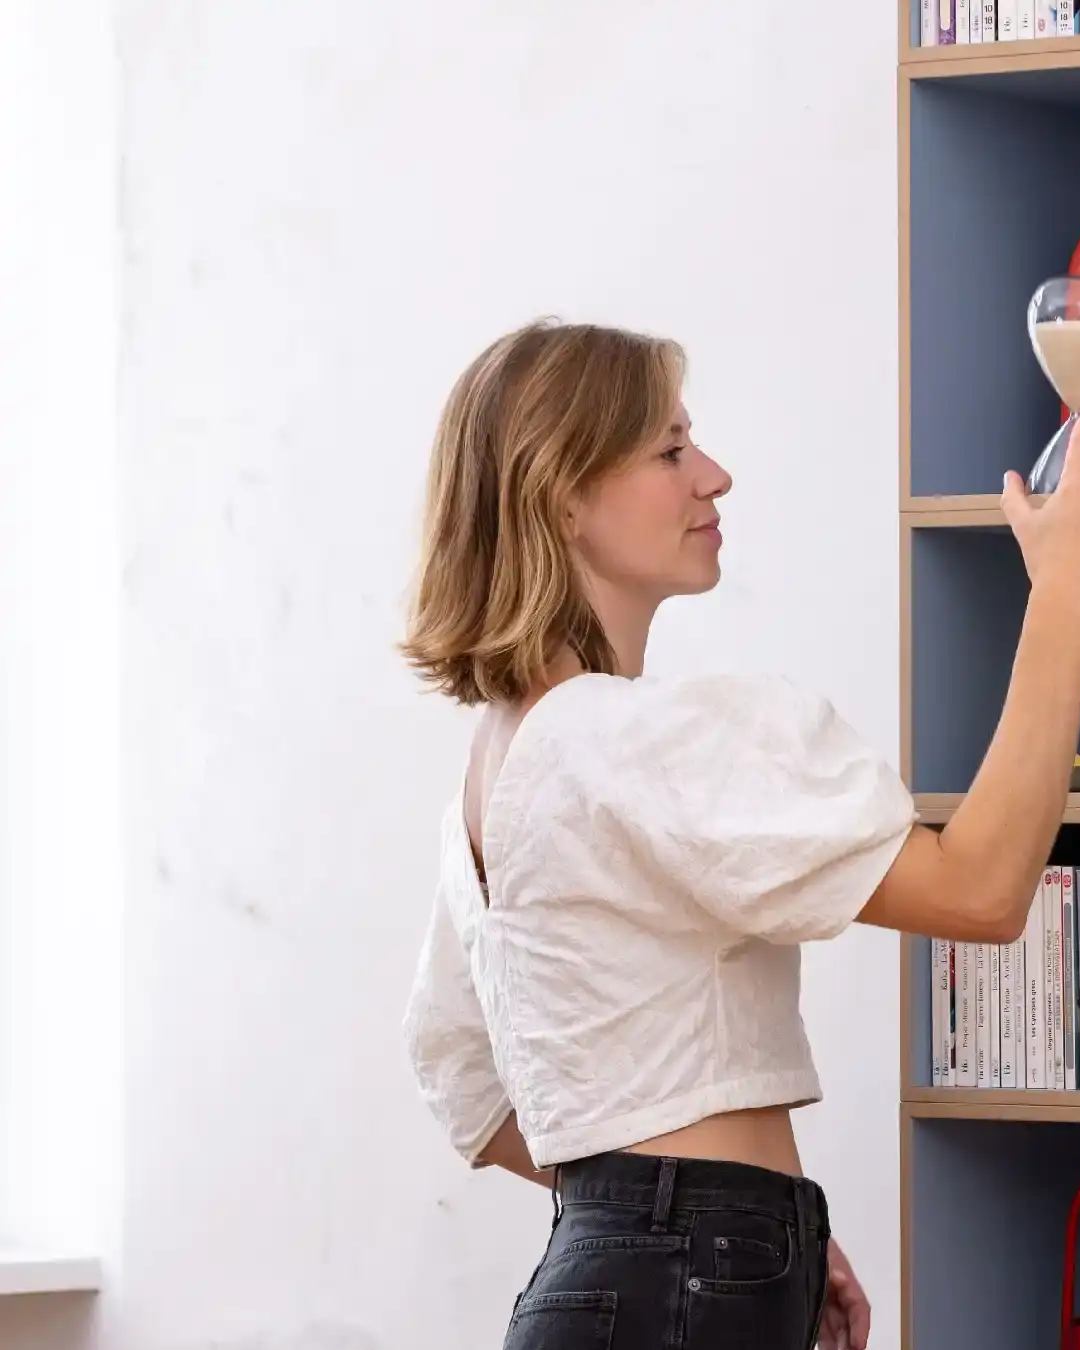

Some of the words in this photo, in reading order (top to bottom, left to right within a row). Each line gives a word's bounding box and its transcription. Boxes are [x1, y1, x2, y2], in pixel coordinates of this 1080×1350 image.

[984, 4, 993, 13] 10
[1059, 1, 1068, 9] 10
[984, 16, 993, 25] 18
[1059, 13, 1068, 21] 18
[1030, 979, 1038, 996] grecs
[1003, 987, 1011, 1013] Pennac
[1030, 997, 1038, 1026] Cyniques
